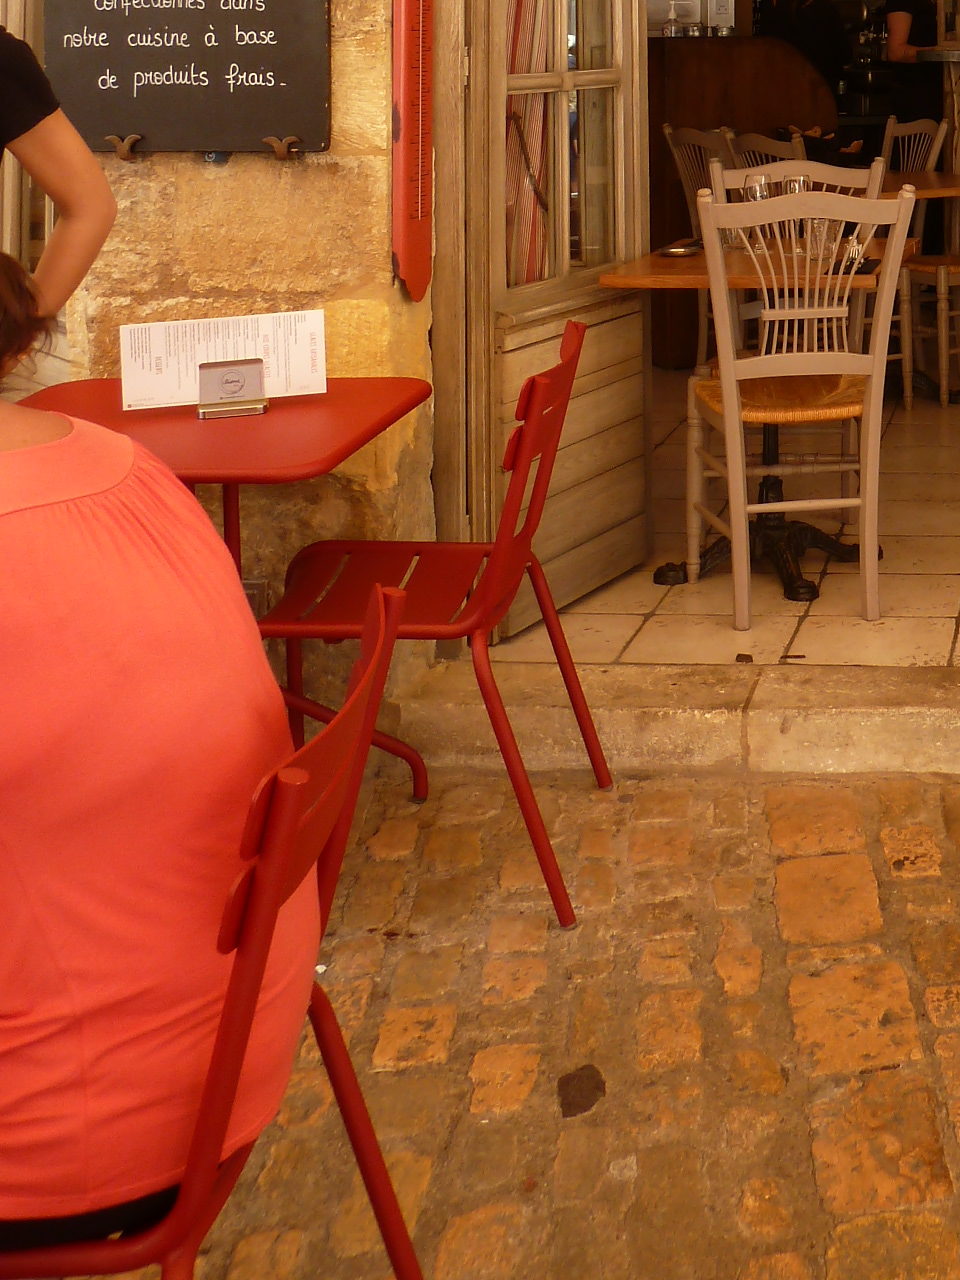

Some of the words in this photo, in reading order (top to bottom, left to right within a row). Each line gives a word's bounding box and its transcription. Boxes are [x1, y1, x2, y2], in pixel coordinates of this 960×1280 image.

[63, 26, 110, 48] notre
[127, 25, 190, 48] cuisine
[204, 24, 219, 47] à
[235, 24, 278, 45] base
[98, 69, 119, 90] de
[133, 63, 209, 98] produits
